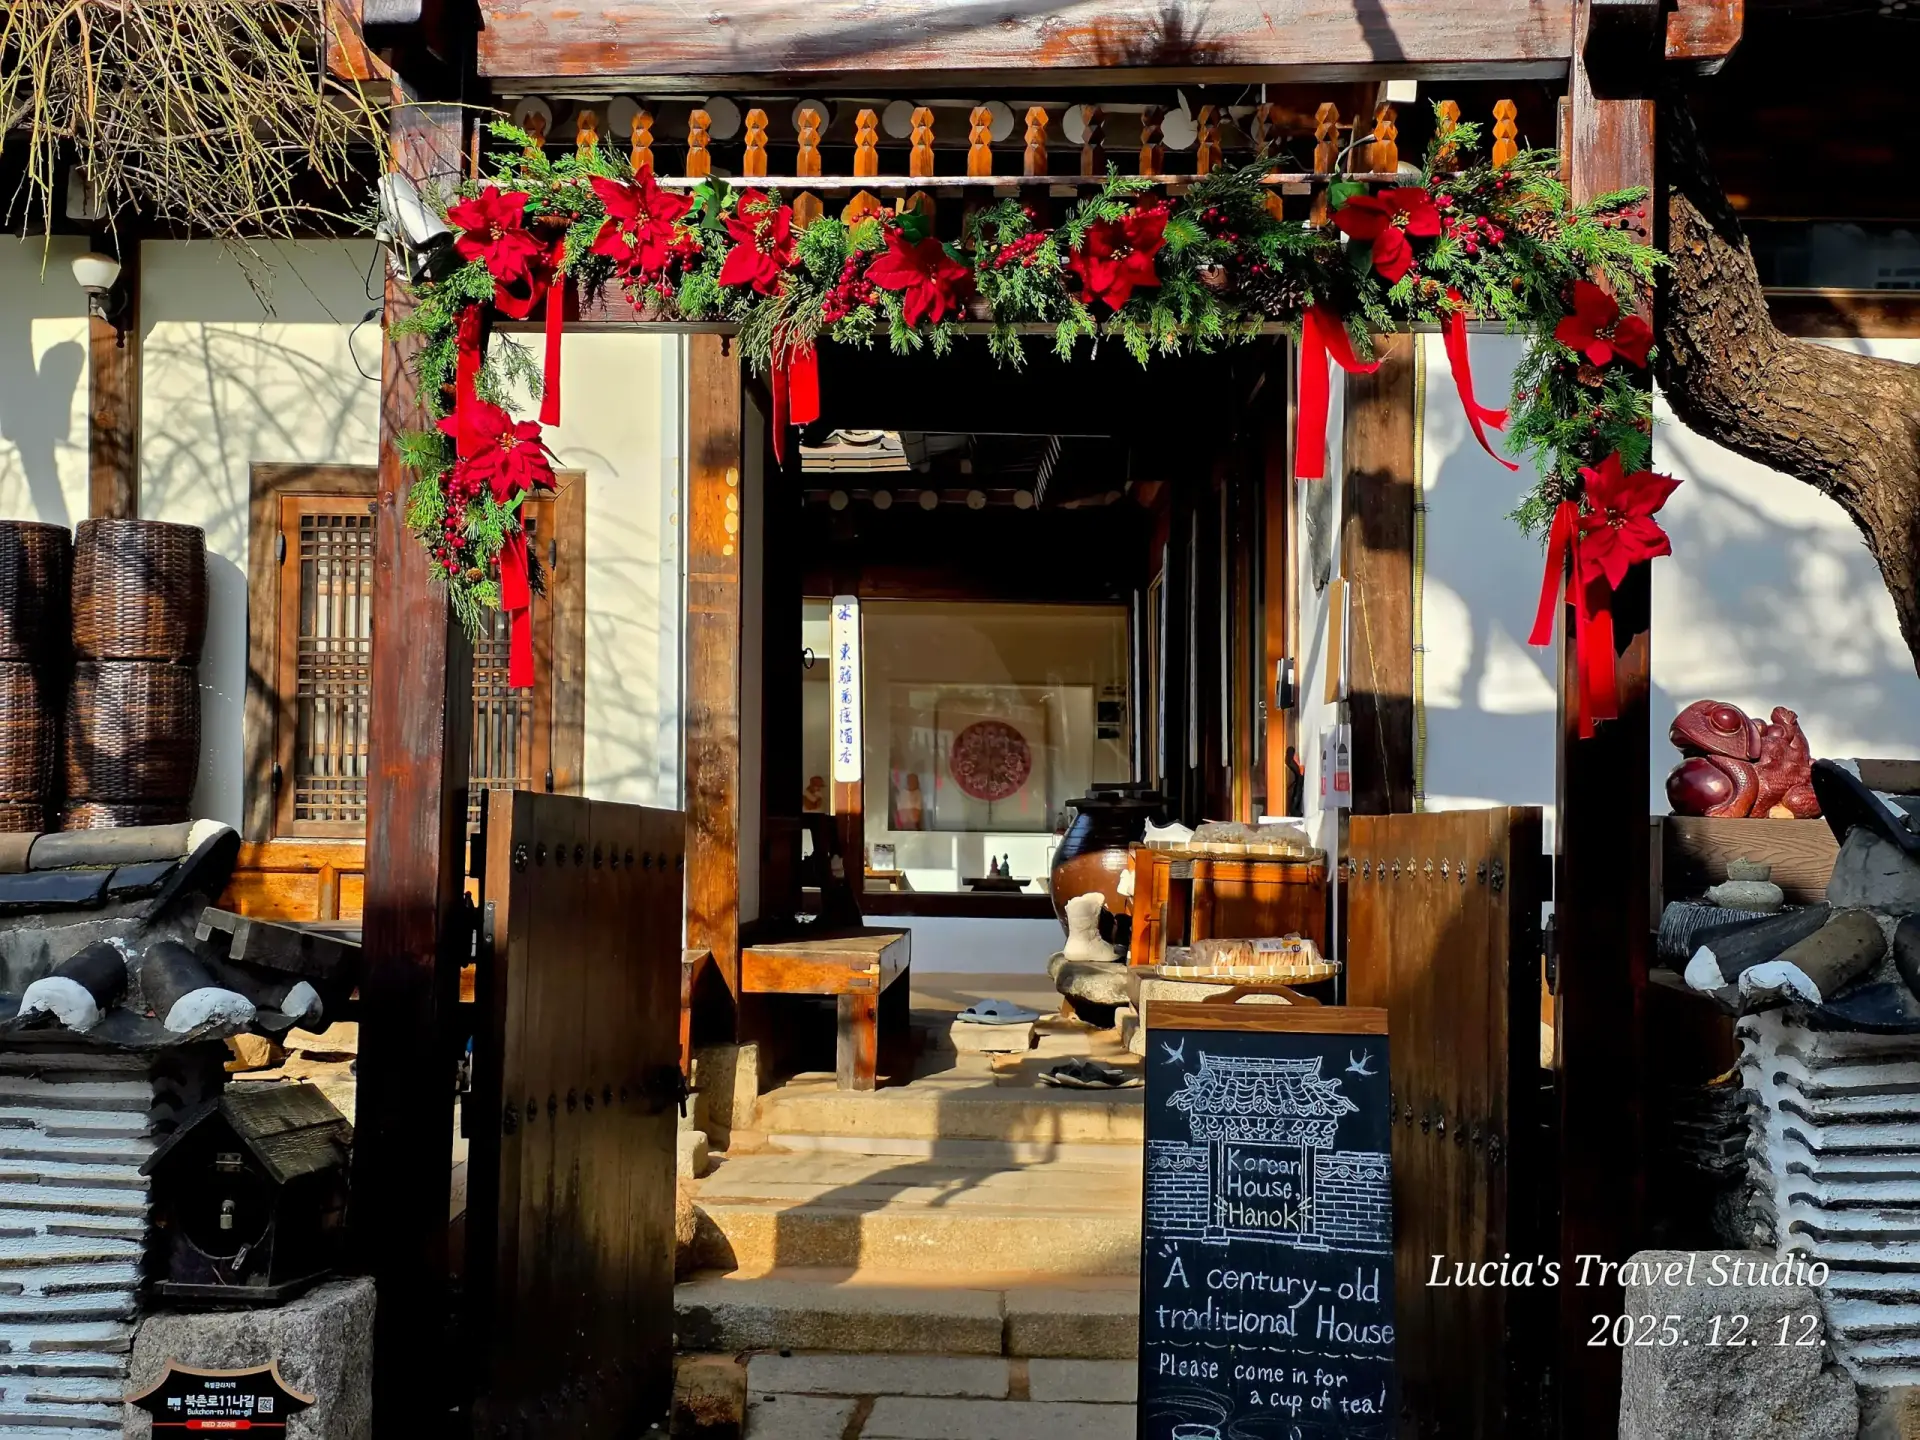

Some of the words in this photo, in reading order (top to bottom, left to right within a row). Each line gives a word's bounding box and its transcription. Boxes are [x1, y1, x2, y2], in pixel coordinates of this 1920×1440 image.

[1227, 1147, 1301, 1175] Korean
[1227, 1174, 1301, 1200] House,
[1229, 1201, 1300, 1231] Hanok
[1162, 1256, 1190, 1288] A
[1206, 1266, 1380, 1309] century-old
[1155, 1296, 1299, 1337] traditional
[1316, 1304, 1395, 1344] House
[1159, 1352, 1219, 1379] Please
[1234, 1363, 1284, 1383] come
[1292, 1367, 1309, 1385] in
[1313, 1368, 1348, 1387] for
[184, 1394, 255, 1408] 북촌로11나길
[187, 1408, 225, 1416] Bukchon-ro
[1250, 1390, 1263, 1405] a
[1270, 1392, 1302, 1417] cup
[1311, 1390, 1331, 1409] of
[1339, 1388, 1386, 1414] tea!
